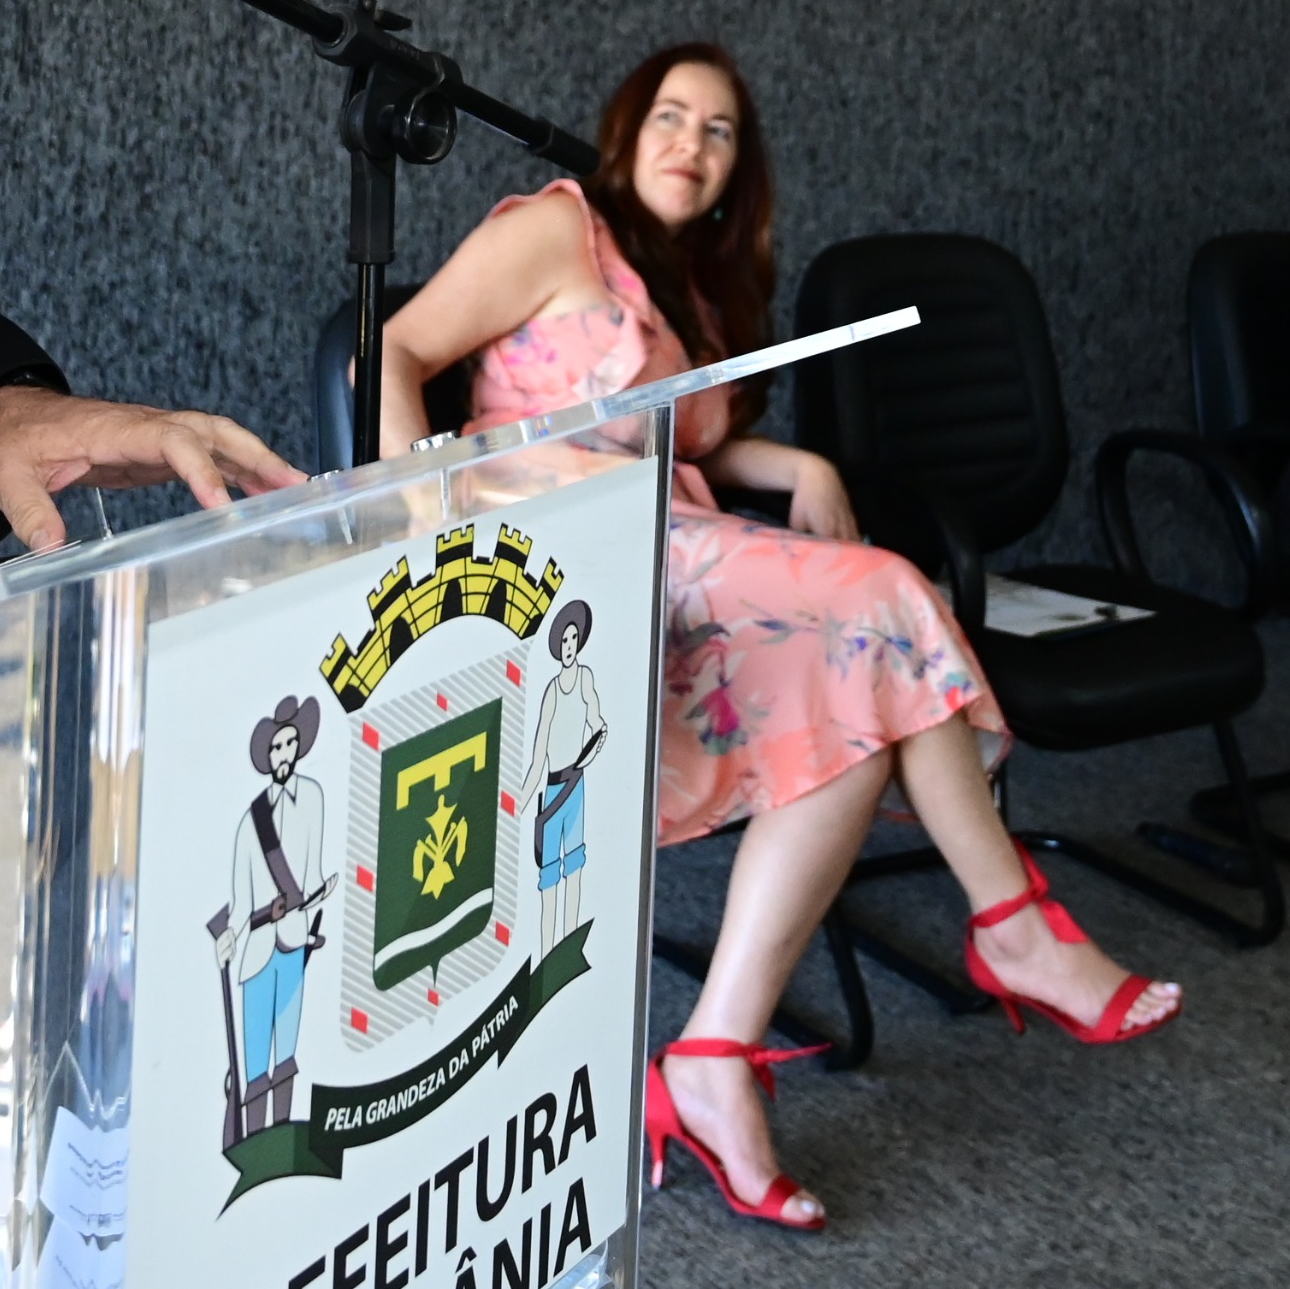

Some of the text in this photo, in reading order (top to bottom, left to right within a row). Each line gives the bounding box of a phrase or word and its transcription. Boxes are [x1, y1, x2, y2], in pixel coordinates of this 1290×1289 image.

[324, 995, 519, 1132] PELA GRANDEZA DA PÁTRIA
